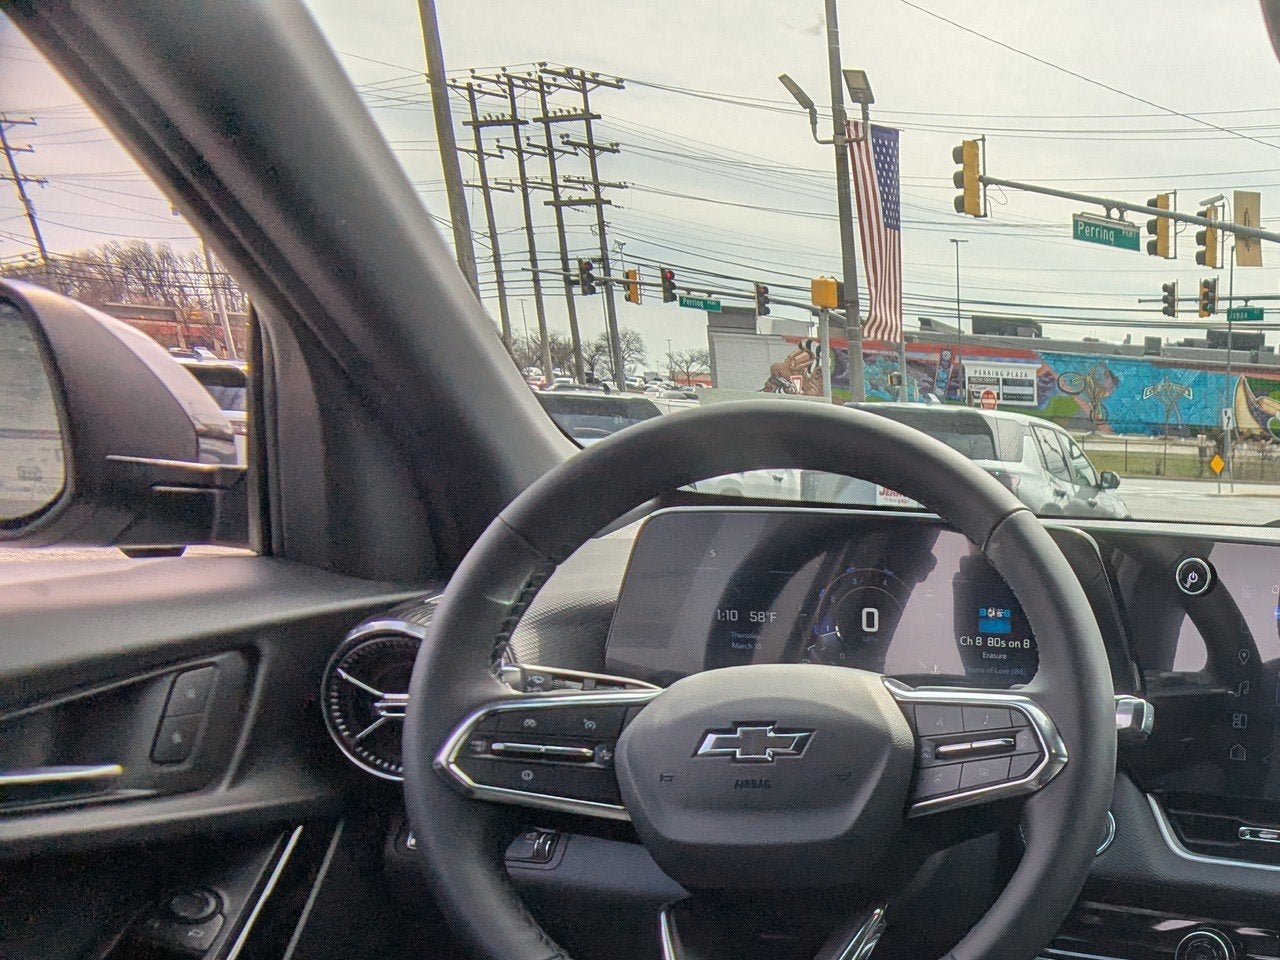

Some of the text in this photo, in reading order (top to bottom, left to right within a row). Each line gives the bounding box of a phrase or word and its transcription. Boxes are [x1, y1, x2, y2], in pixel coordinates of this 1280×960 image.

[1078, 221, 1115, 245] Perring
[716, 610, 777, 622] 1:10 58°F
[862, 608, 879, 632] 0
[960, 636, 973, 646] Ch
[976, 636, 982, 646] 8
[987, 637, 1006, 648] 80s
[1023, 639, 1030, 649] 8
[982, 652, 1007, 660] Erasure
